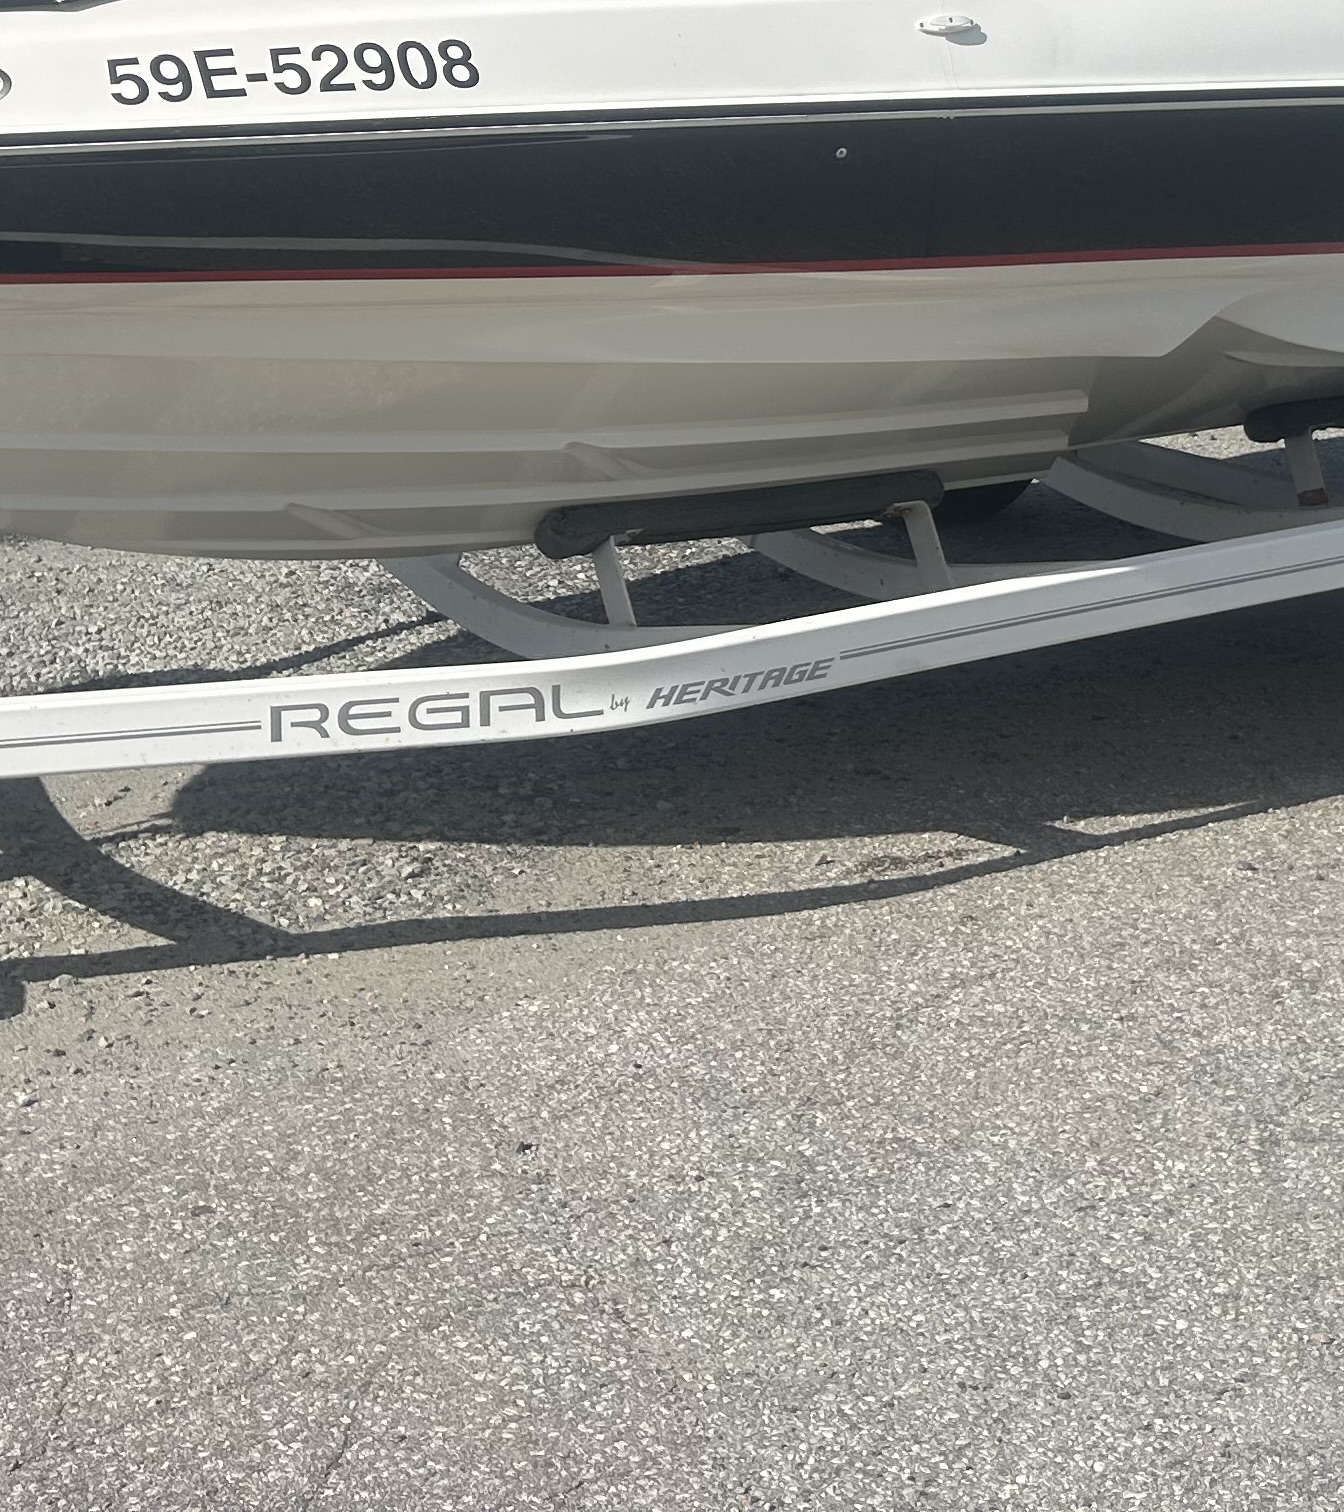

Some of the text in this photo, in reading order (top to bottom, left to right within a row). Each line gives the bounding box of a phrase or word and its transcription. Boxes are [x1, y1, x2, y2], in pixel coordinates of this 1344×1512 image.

[107, 39, 480, 106] 59E-52908
[270, 657, 836, 742] REGAL by HERITAGE
